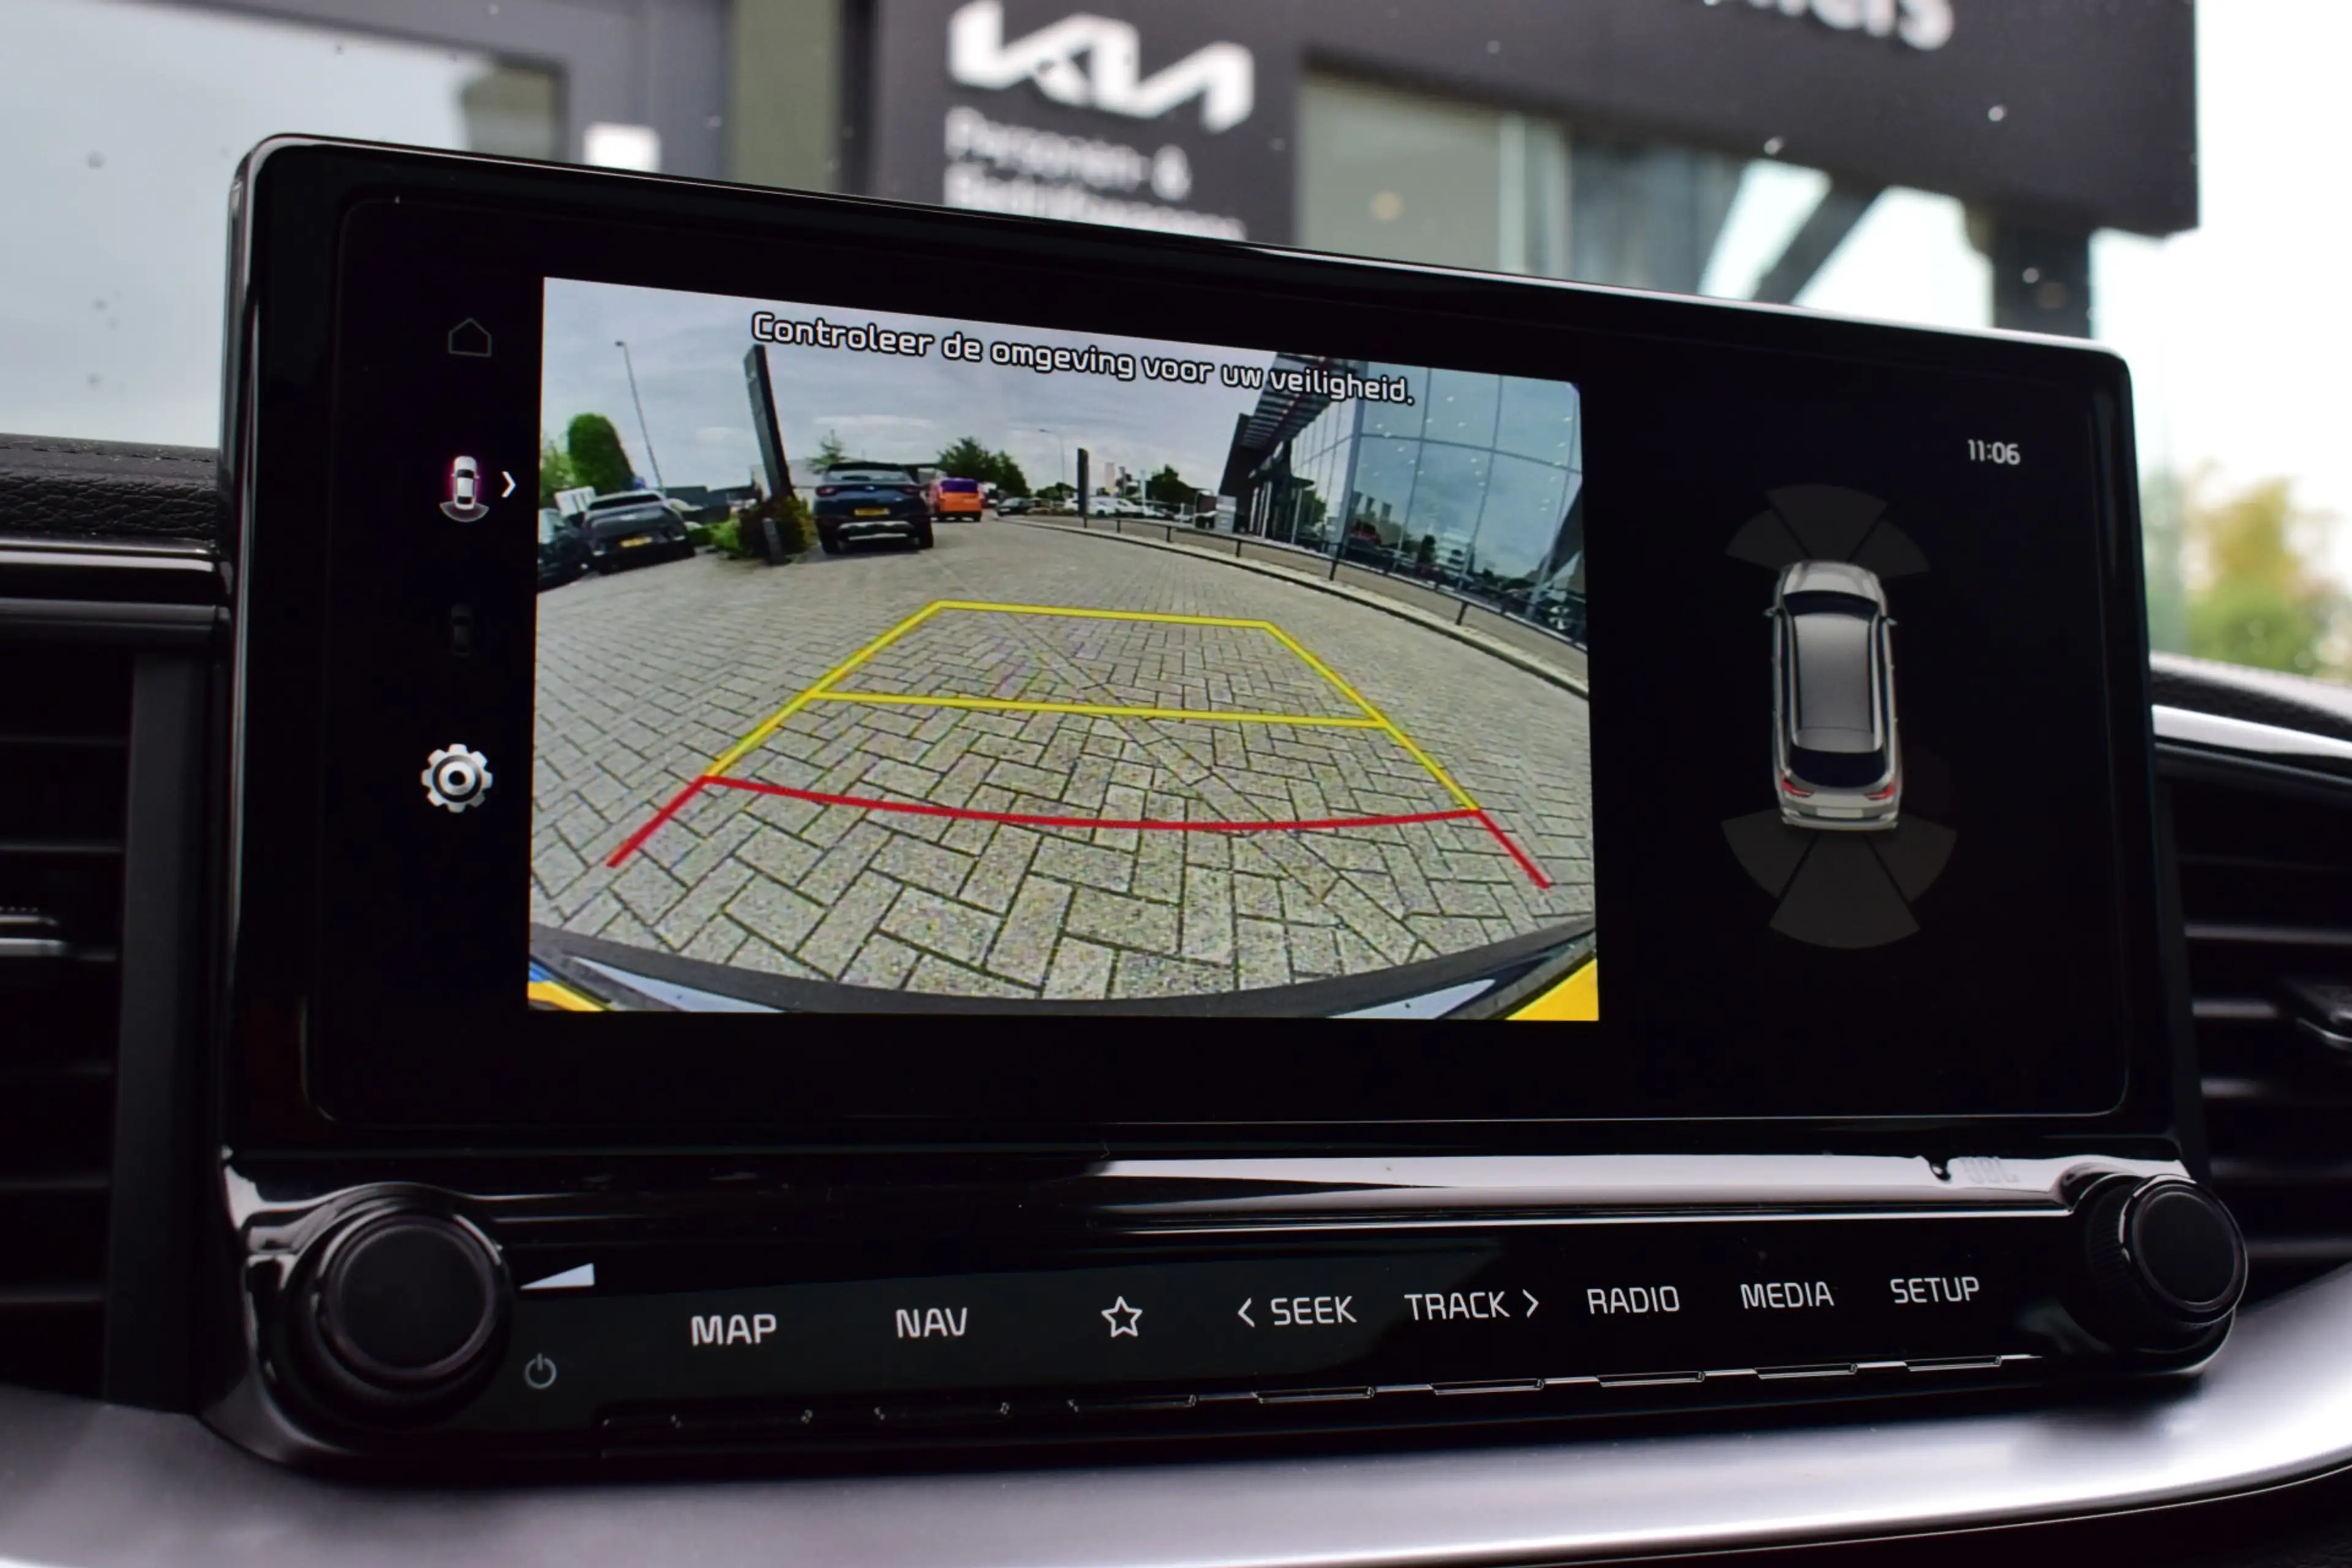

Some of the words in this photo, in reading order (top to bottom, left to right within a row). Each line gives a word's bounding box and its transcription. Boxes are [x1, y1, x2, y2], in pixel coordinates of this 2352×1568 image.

[752, 311, 935, 356] Controleer
[941, 331, 982, 362] de
[990, 341, 1136, 383] omgeving
[1142, 356, 1215, 383] voor
[1221, 363, 1263, 390] uw
[1270, 368, 1415, 406] veiligheid.
[1968, 439, 2021, 466] 11:06
[1587, 1286, 1680, 1315] RADIO
[1740, 1281, 1834, 1310] MEDIA
[1890, 1276, 1980, 1304] SETUP
[1270, 1295, 1357, 1325] SEEK
[1404, 1291, 1510, 1321] TRACK
[691, 1314, 777, 1346] MAP
[895, 1307, 968, 1338] NAV
